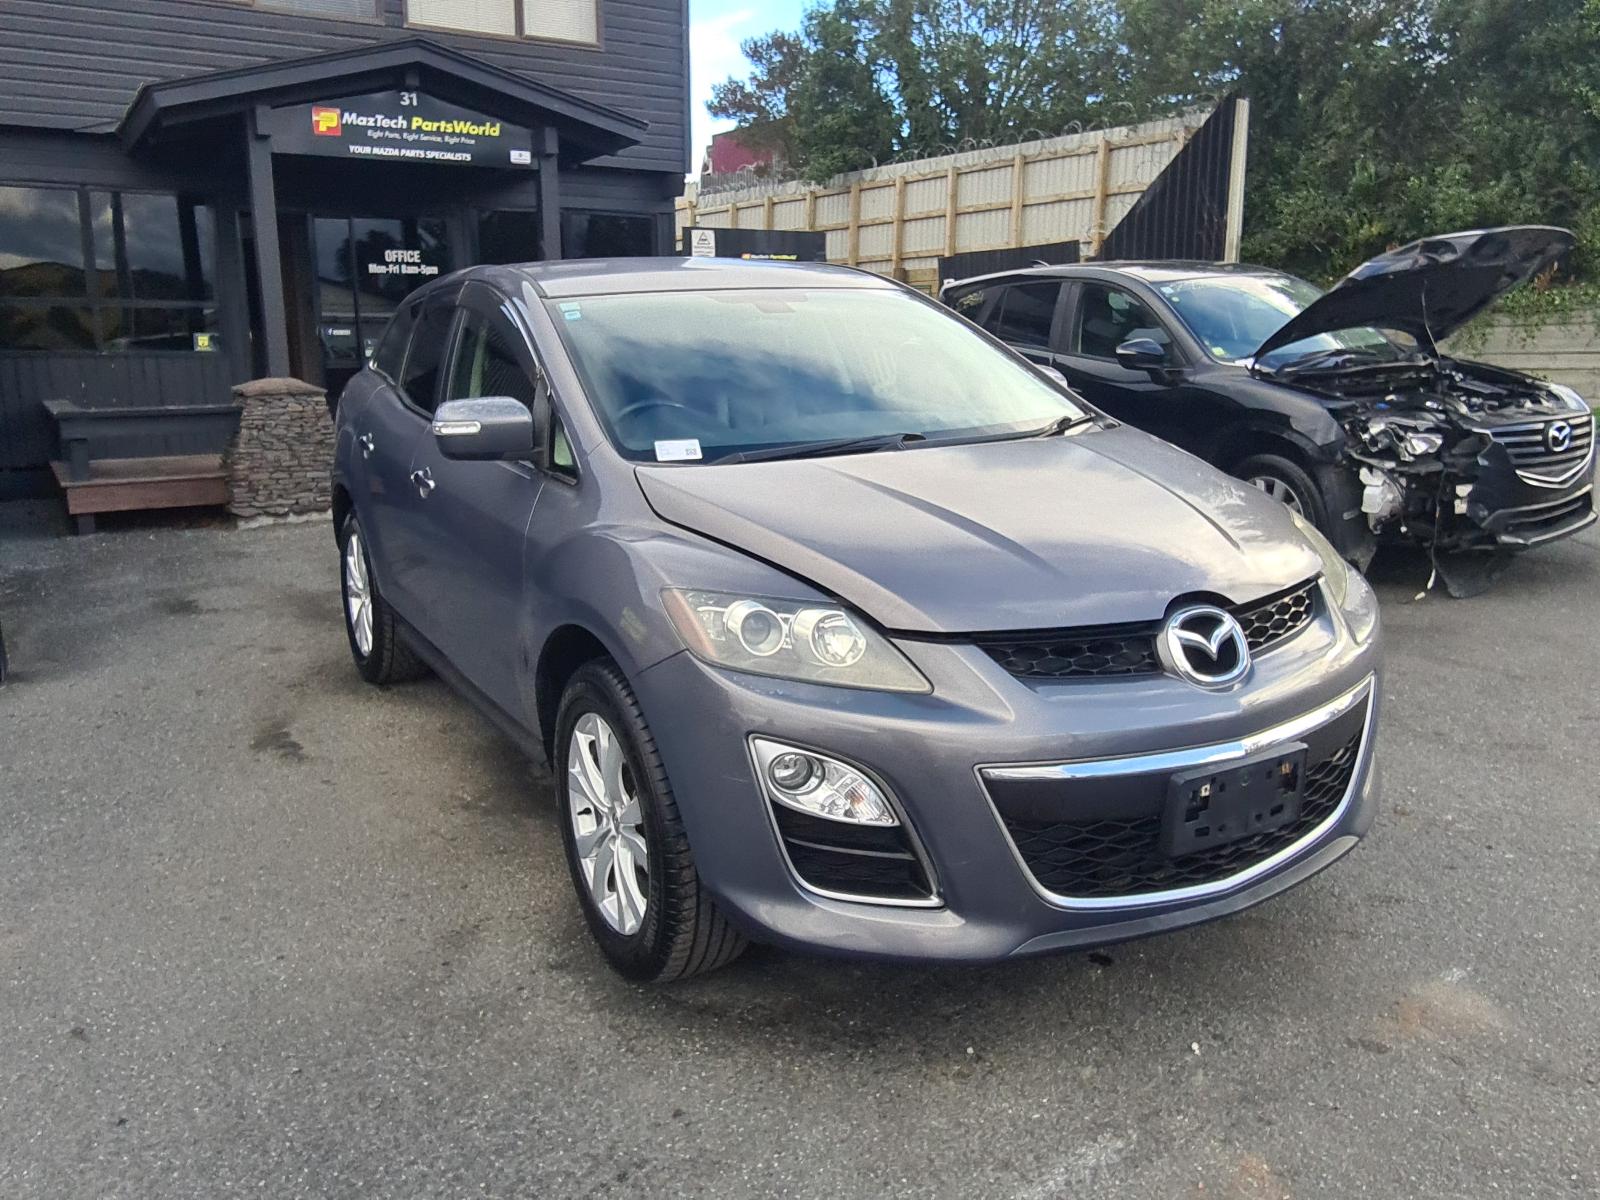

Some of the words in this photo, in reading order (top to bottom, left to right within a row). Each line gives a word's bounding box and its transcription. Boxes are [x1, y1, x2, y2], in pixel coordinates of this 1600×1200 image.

[400, 92, 418, 106] 31
[341, 112, 407, 129] MazTech
[411, 116, 500, 136] PartsWorld
[367, 129, 384, 139] Right
[403, 132, 419, 142] Right
[349, 145, 372, 154] YOUR
[372, 146, 399, 156] MAZDA
[400, 148, 425, 158] PARTS
[425, 150, 472, 161] SPECIALISTS
[384, 250, 421, 263] OFFICE
[368, 263, 400, 274] Mon-Fri
[401, 264, 438, 275] 8am-5pm
